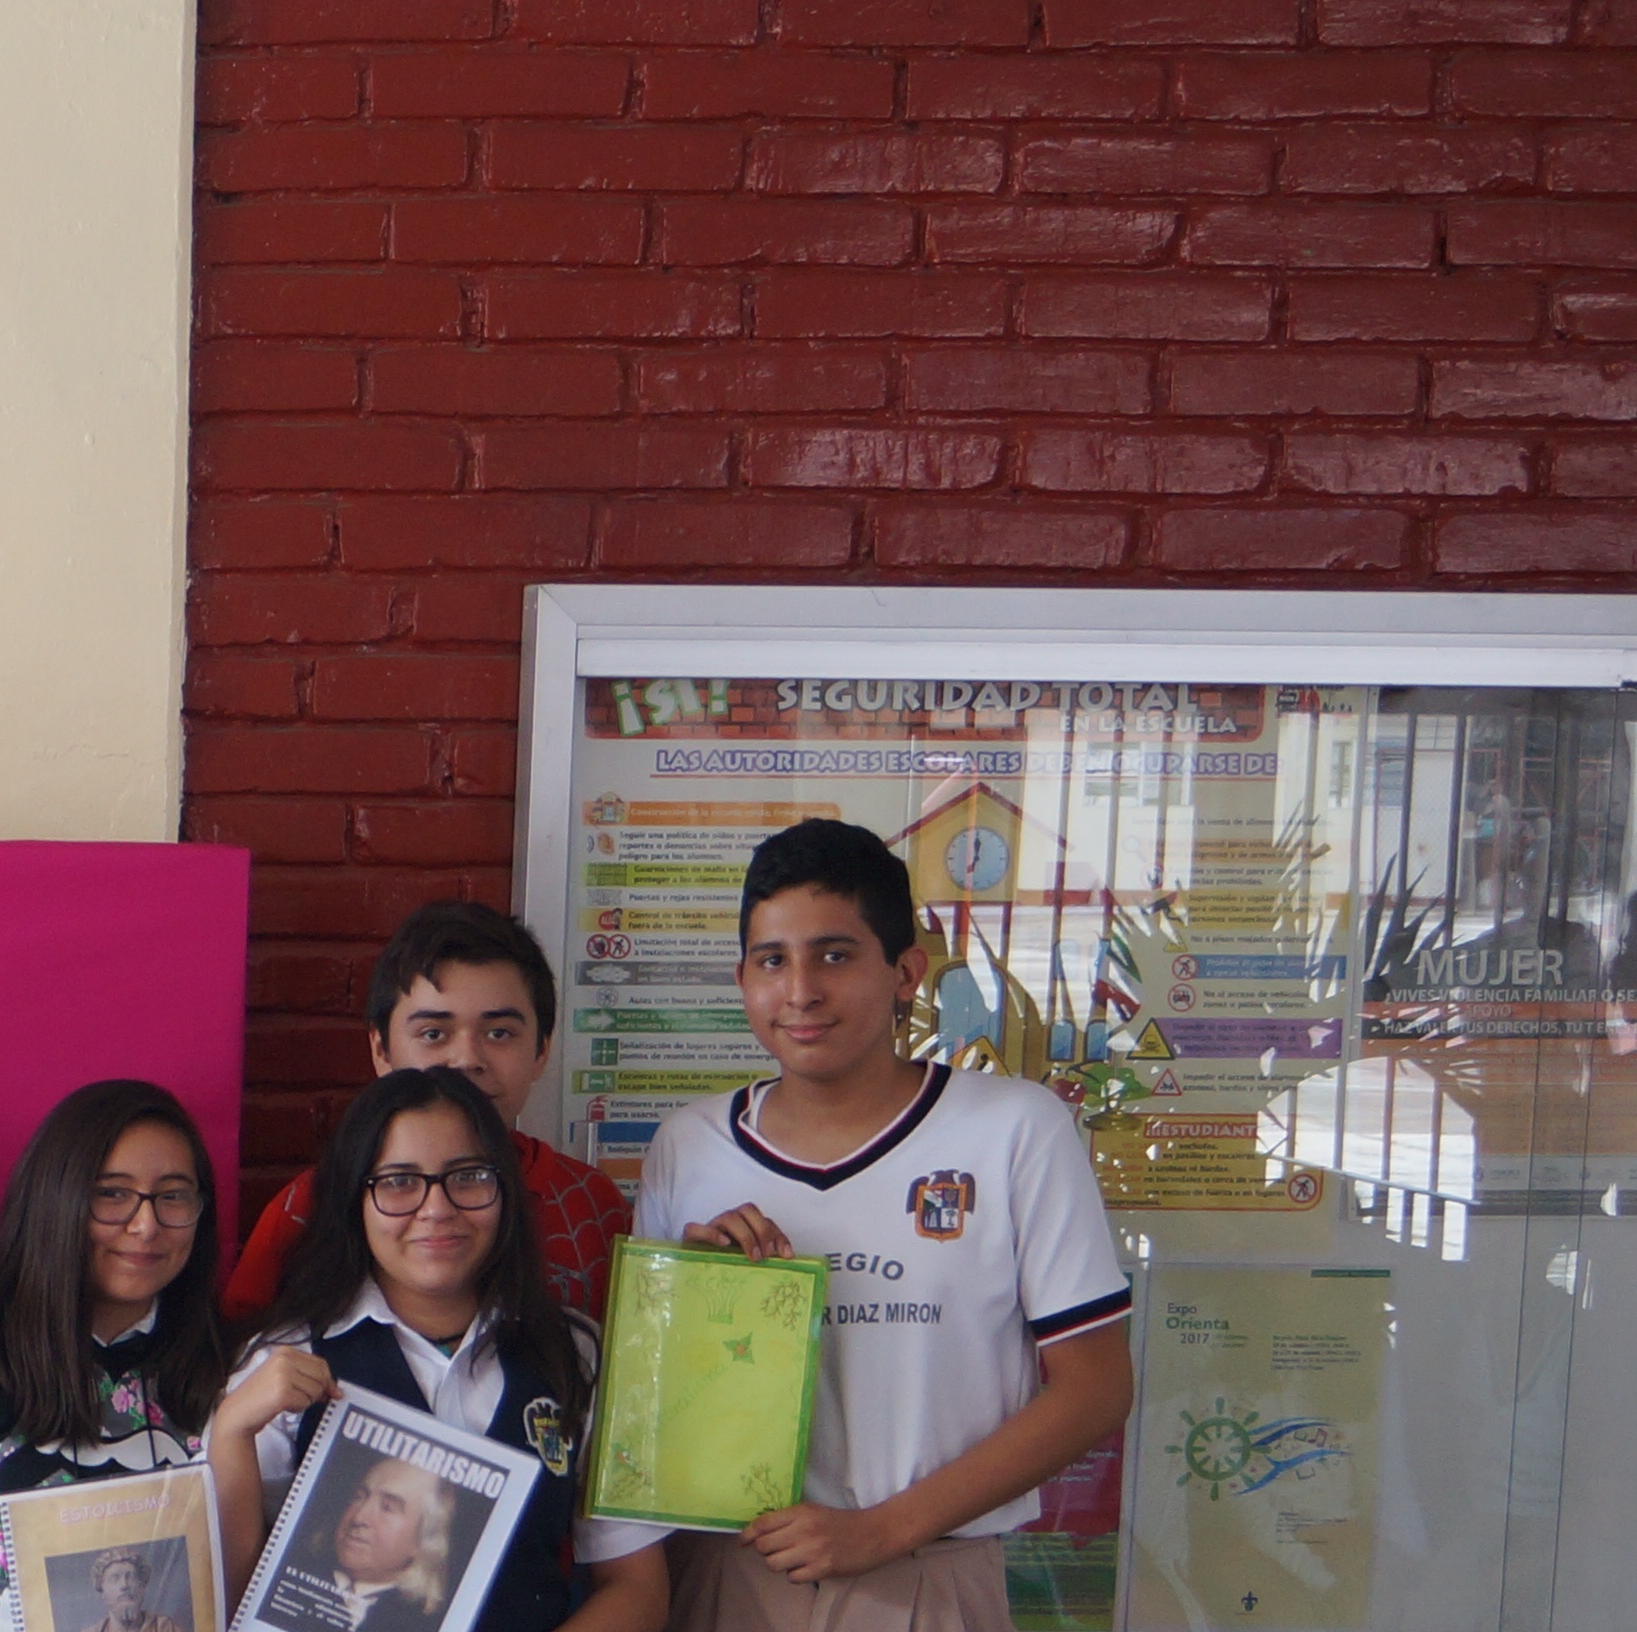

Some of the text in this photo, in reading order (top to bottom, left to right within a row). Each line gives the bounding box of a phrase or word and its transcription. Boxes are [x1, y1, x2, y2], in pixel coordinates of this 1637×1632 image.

[777, 681, 1042, 713] SEGURIDAD
[1050, 682, 1198, 713] TOTAL
[1060, 716, 1237, 733] EN LA ESCUELA
[656, 750, 702, 773] LAS
[704, 750, 882, 773] AUTORIDADES
[886, 750, 1023, 774] ESCOLARES
[1027, 750, 1109, 775] DEBEN
[1113, 751, 1238, 776] OCUPARSE
[1416, 949, 1565, 987] MUJER
[1524, 989, 1596, 1003] FAMILIAR
[1464, 1004, 1511, 1017] APOYO
[1487, 1022, 1562, 1037] DERECHOS,
[1566, 1022, 1581, 1035] TU
[610, 1111, 629, 1120] para
[825, 1252, 905, 1281] EGIO
[837, 1302, 943, 1326] DIAZ MIRON
[1167, 1302, 1197, 1317] Expo
[1165, 1316, 1230, 1331] Orienta
[1180, 1332, 1210, 1345] 2017
[342, 1411, 506, 1499] UTILITARISMO
[59, 1496, 170, 1525] ESTOICISMO
